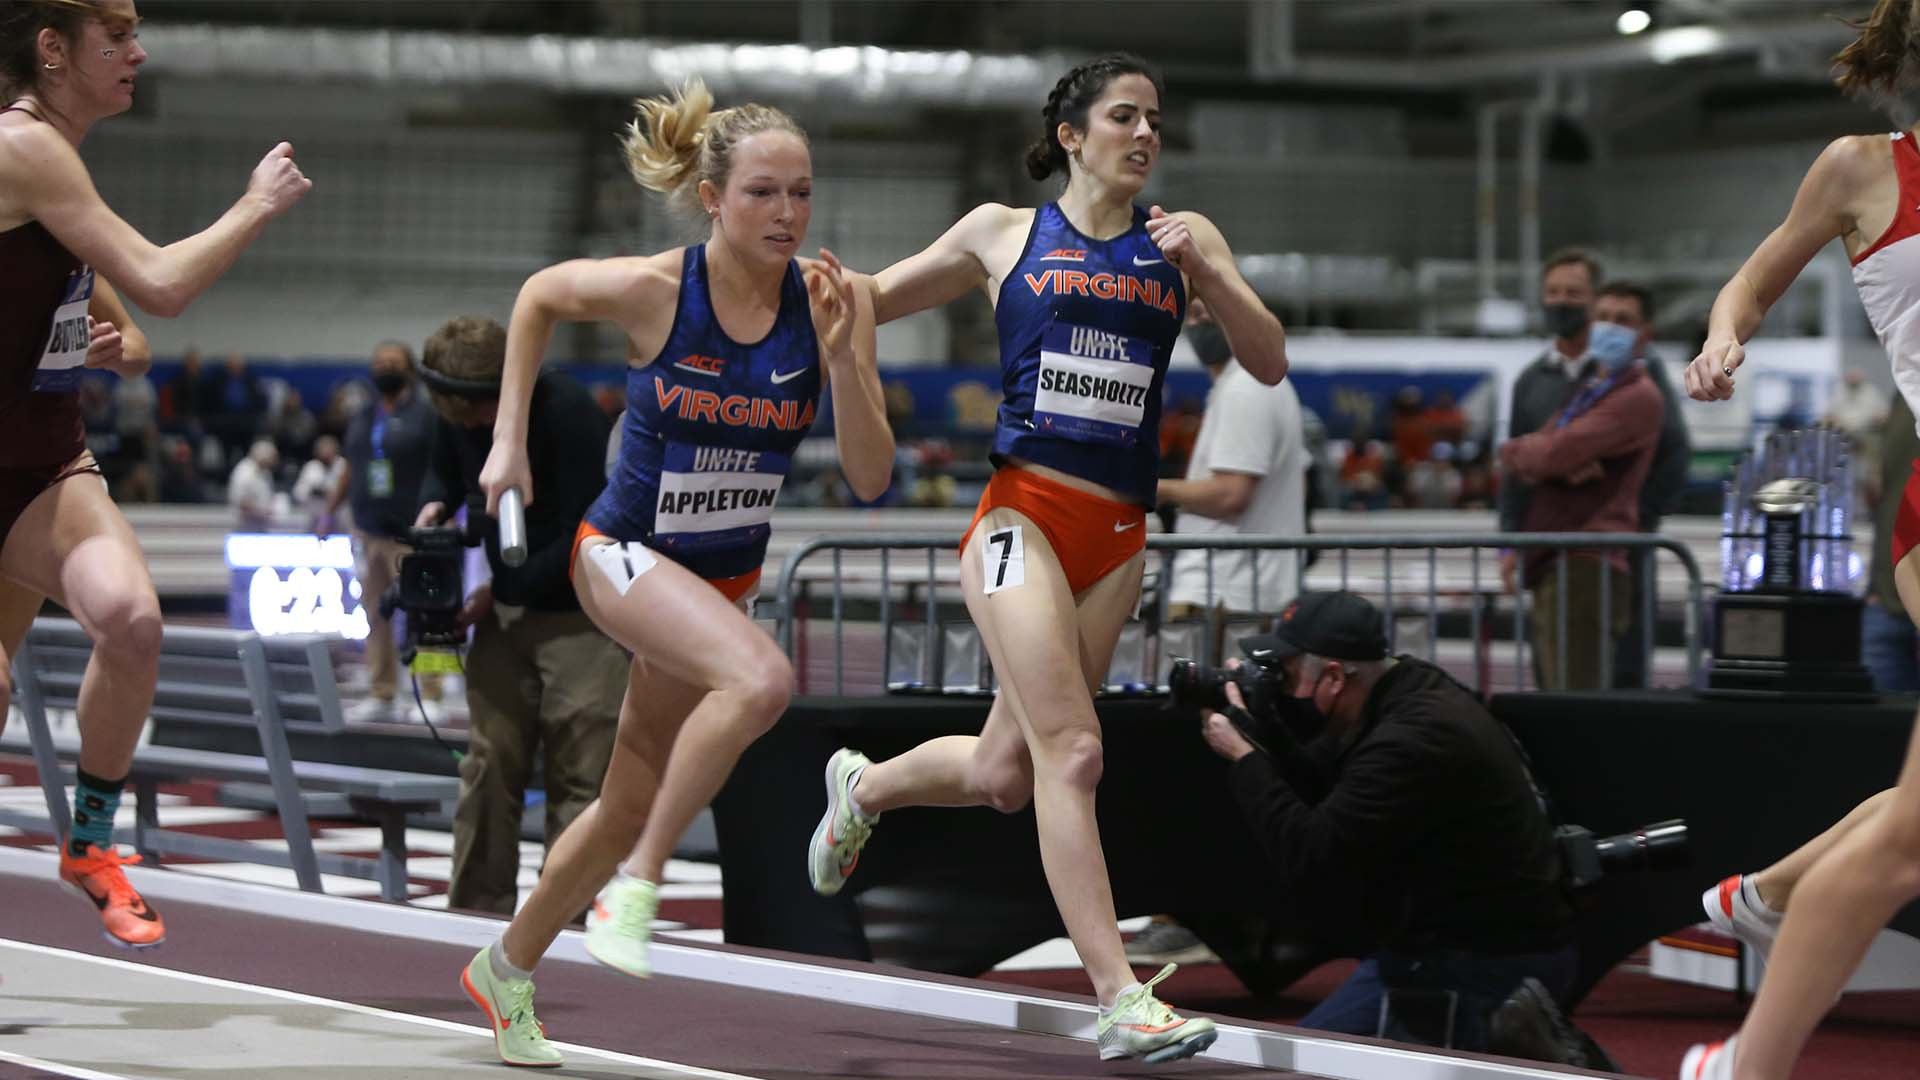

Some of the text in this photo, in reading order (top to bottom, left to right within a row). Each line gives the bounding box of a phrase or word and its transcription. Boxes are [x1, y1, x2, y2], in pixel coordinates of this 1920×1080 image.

[1042, 248, 1088, 260] ACC
[1024, 269, 1177, 319] VIRGINIA
[1070, 326, 1130, 361] UNITE
[676, 354, 726, 374] ACC
[655, 376, 815, 431] VIRGINIA
[1041, 368, 1145, 407] SEASHOLTZ
[693, 446, 760, 472] UNITE
[659, 488, 776, 514] APPLETON
[990, 531, 1013, 587] 7
